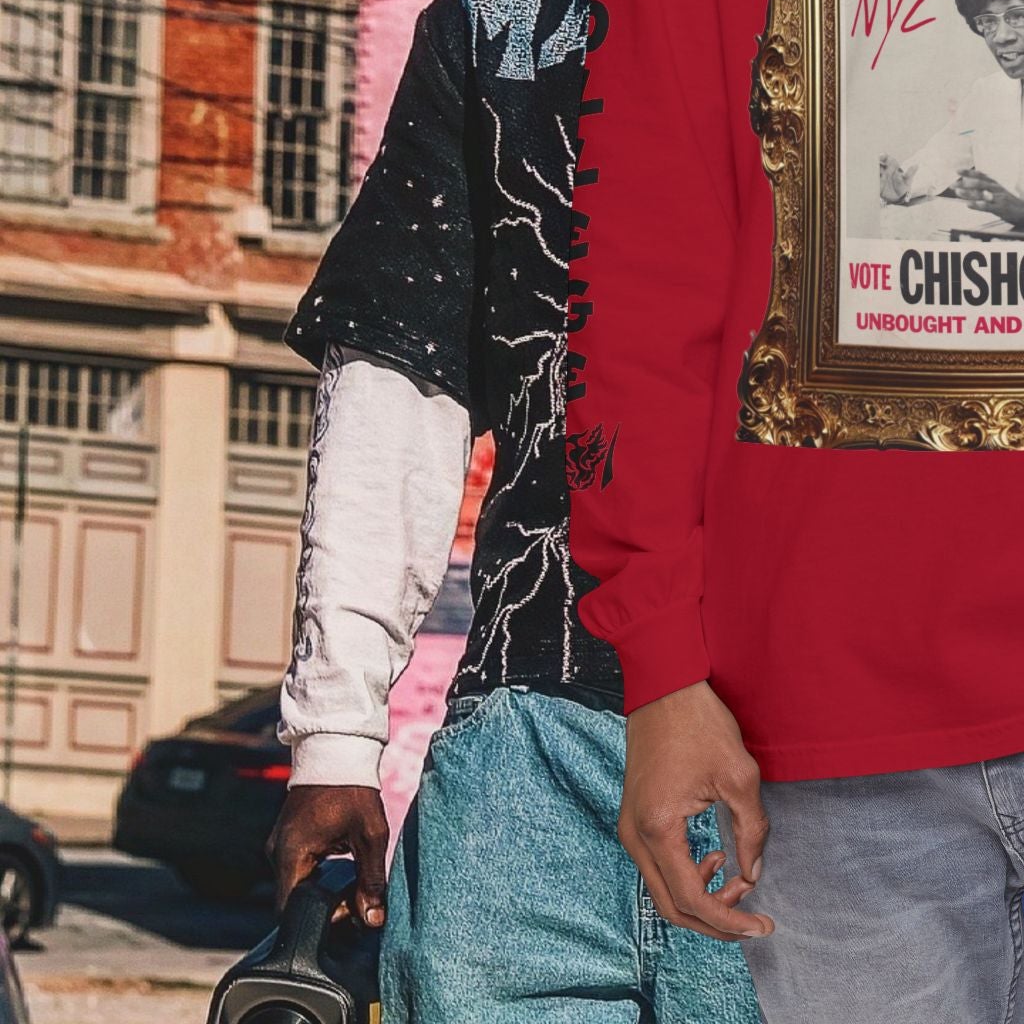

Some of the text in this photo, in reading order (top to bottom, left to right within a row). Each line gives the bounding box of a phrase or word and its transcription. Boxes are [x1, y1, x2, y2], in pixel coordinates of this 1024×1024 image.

[849, 262, 892, 290] VOTE
[856, 312, 967, 334] UNBOUGHT
[974, 315, 1023, 334] AND
